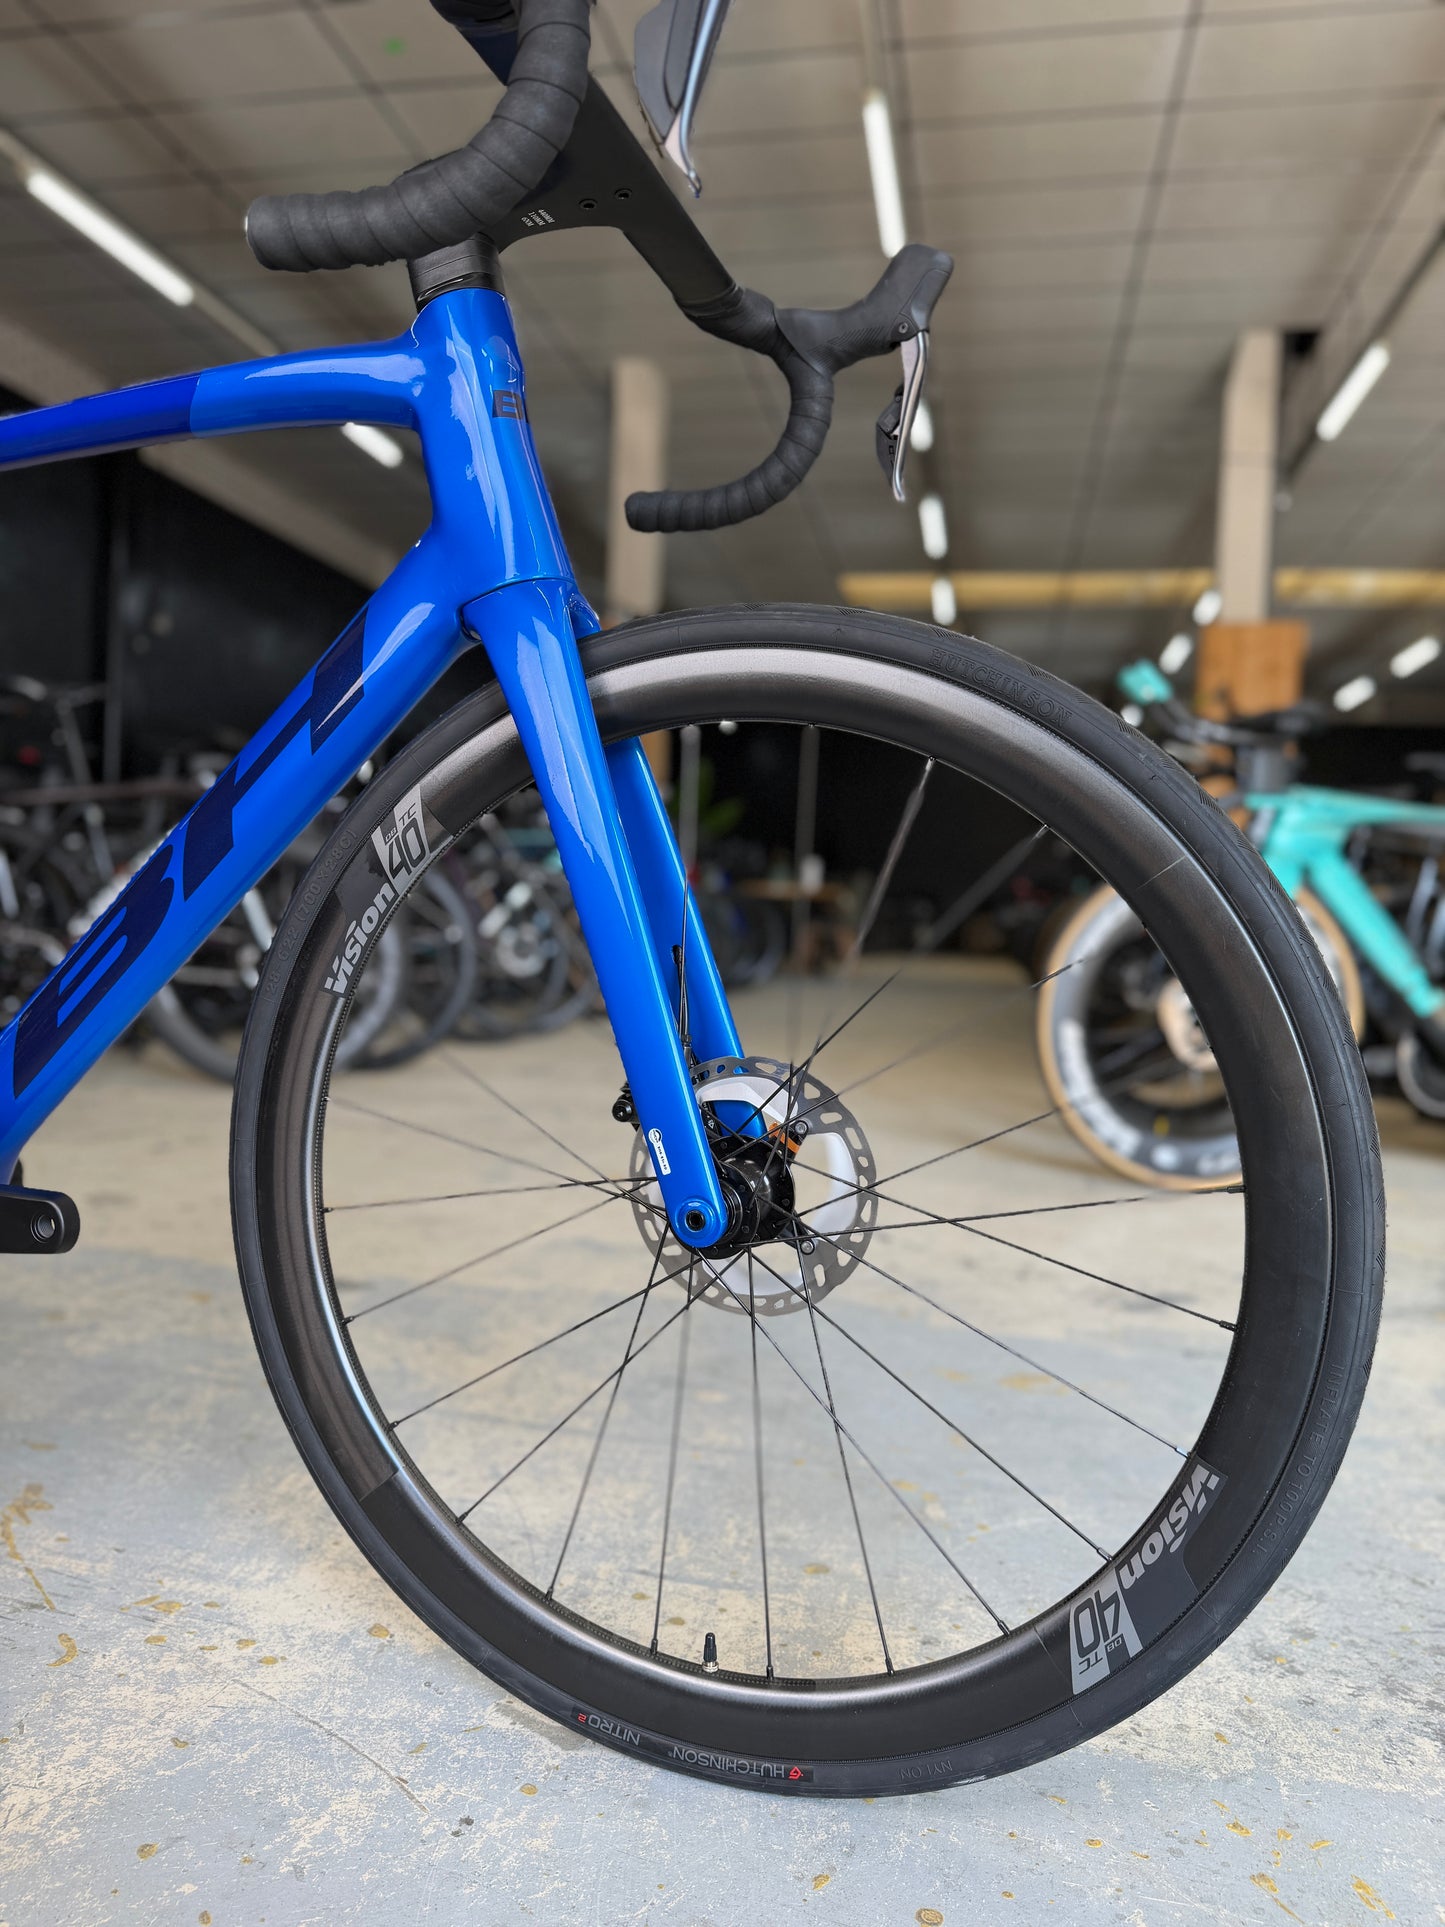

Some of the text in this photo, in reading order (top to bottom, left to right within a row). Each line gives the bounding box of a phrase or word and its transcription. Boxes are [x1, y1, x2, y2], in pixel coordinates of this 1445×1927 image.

[492, 389, 530, 424] B
[928, 649, 1073, 728] HUTCHINSON
[384, 826, 397, 843] DB
[398, 802, 416, 827] TC
[324, 816, 425, 994] Vision 40
[1309, 1363, 1345, 1447] INFLATE
[1297, 1453, 1317, 1477] TO
[1073, 1463, 1221, 1659] Vision 40
[1078, 1637, 1123, 1676] DB TC
[672, 1745, 785, 1778] HUTCHINSON
[899, 1760, 953, 1780] NYLON
